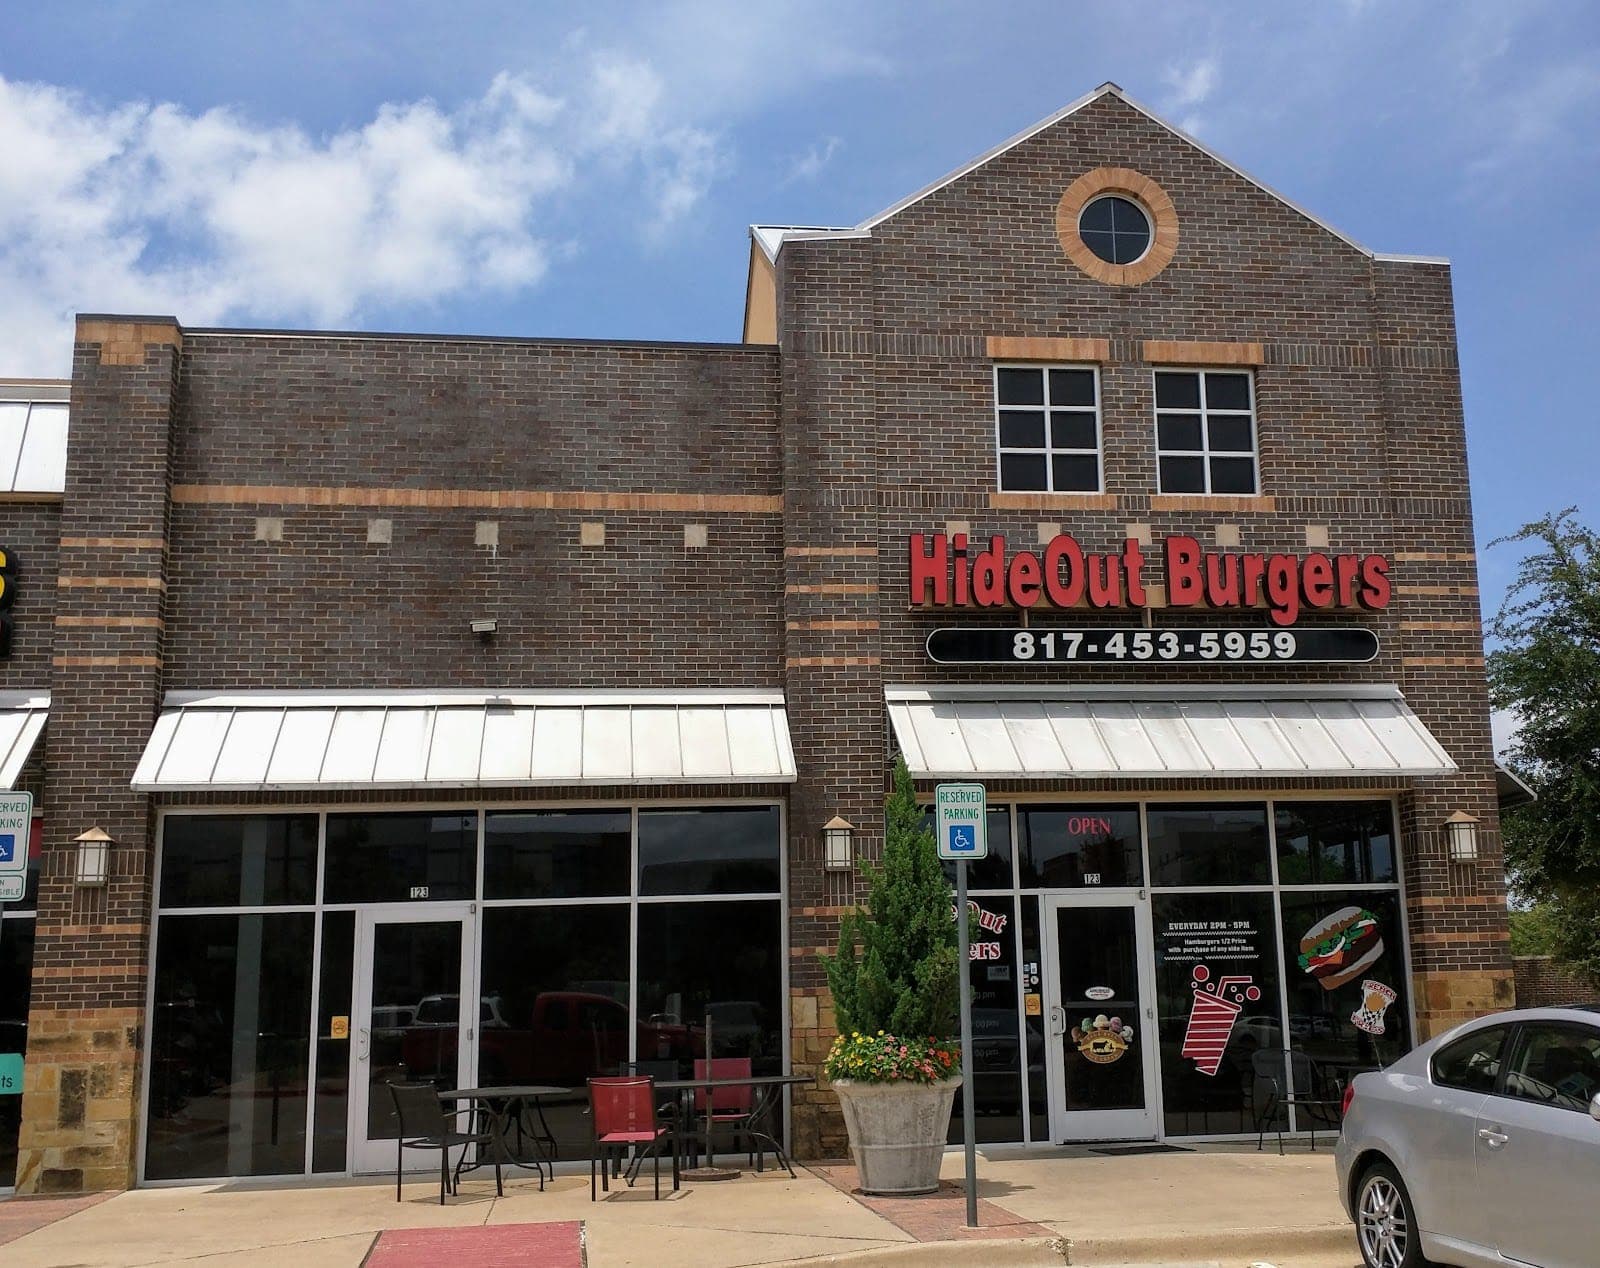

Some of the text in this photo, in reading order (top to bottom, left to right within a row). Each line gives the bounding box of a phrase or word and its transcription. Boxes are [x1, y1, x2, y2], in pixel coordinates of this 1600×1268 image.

[909, 533, 1391, 626] HideOut Burgers
[1013, 631, 1297, 659] 817-453-5959
[940, 791, 982, 803] RESERVED
[943, 807, 979, 820] PARKING
[1068, 817, 1112, 835] OPEN
[1085, 873, 1101, 885] 123
[410, 886, 429, 899] 123
[1168, 922, 1208, 930] EVERYDAY
[1209, 921, 1227, 929] 2PM
[1184, 938, 1220, 946] Hamburgers
